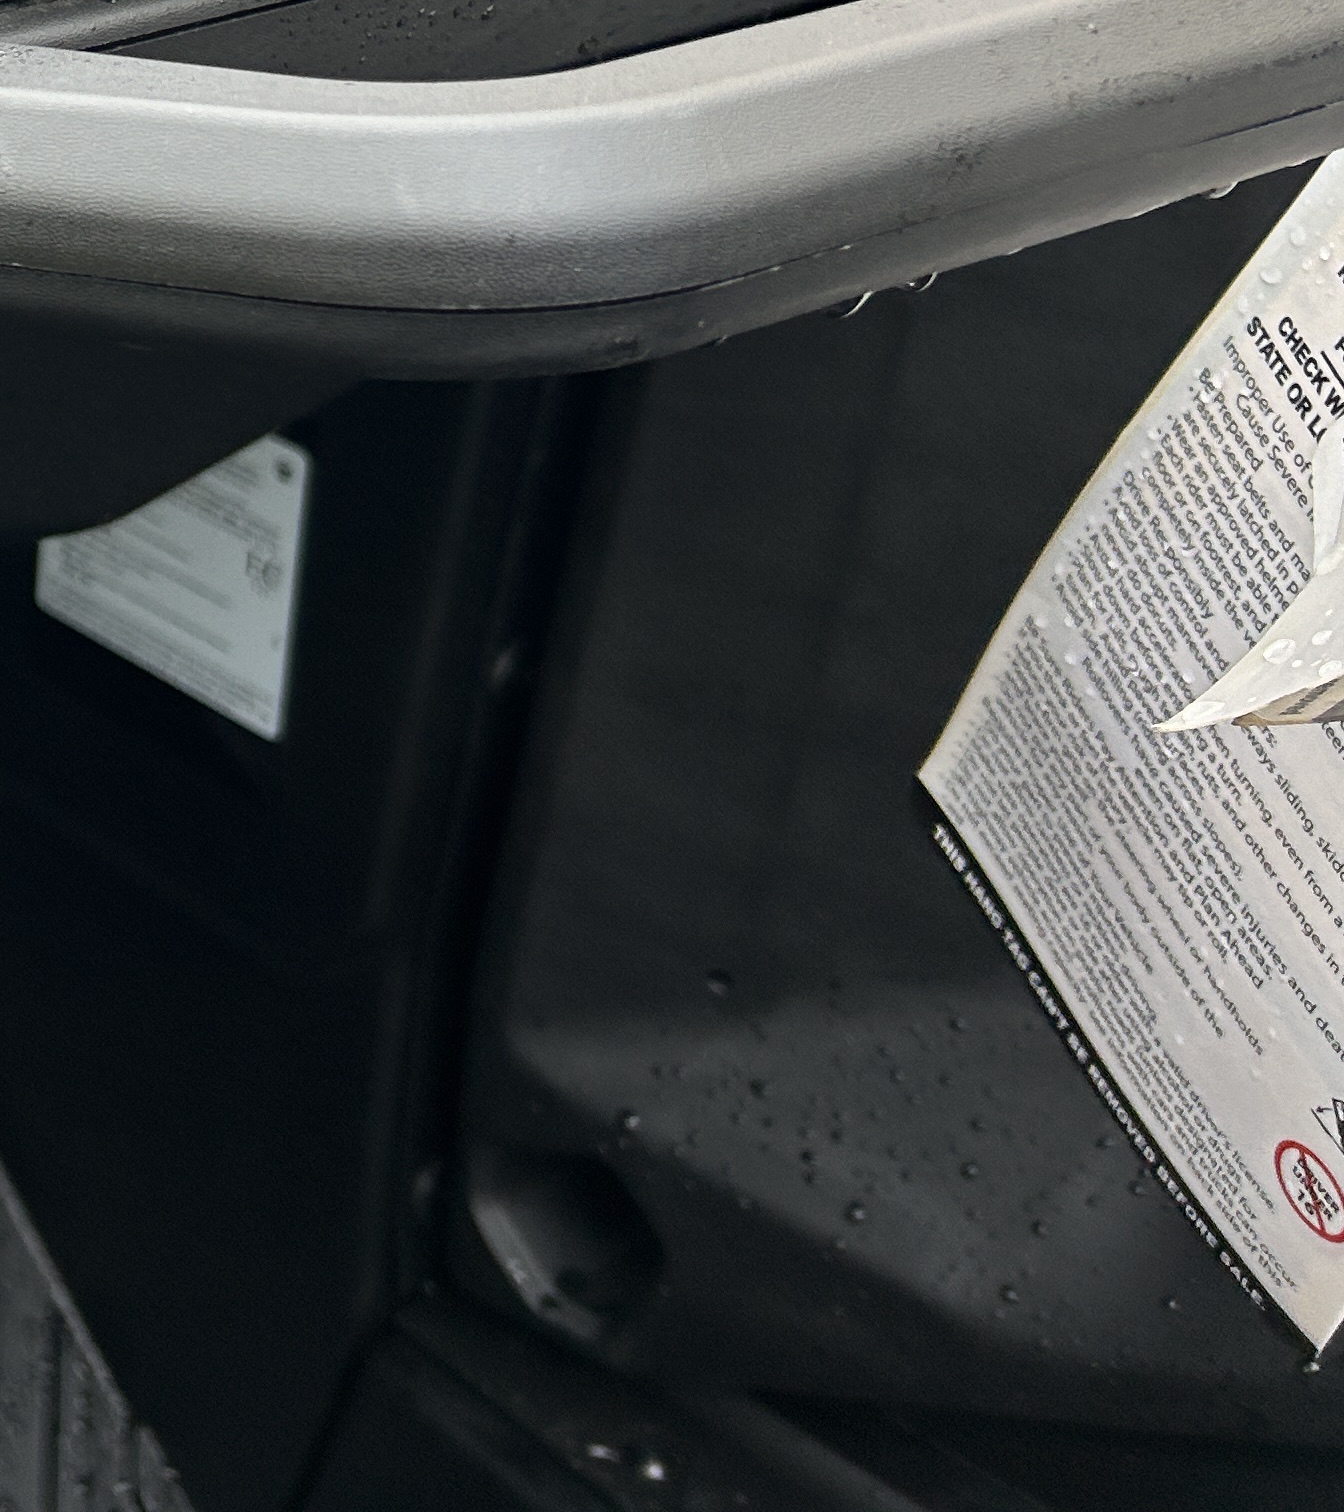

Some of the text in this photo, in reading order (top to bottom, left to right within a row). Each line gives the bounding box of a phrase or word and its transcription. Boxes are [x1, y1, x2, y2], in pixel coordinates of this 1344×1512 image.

[1223, 335, 1274, 417] Improper
[1272, 414, 1295, 454] Use
[1247, 316, 1313, 422] STATE OR
[1278, 316, 1331, 397] CHECK
[1213, 390, 1264, 473] Prepared
[1236, 392, 1309, 510] Cause Severe
[1222, 443, 1295, 554] seat belts and
[1244, 833, 1341, 974] other changes in
[1274, 827, 1334, 915] even from
